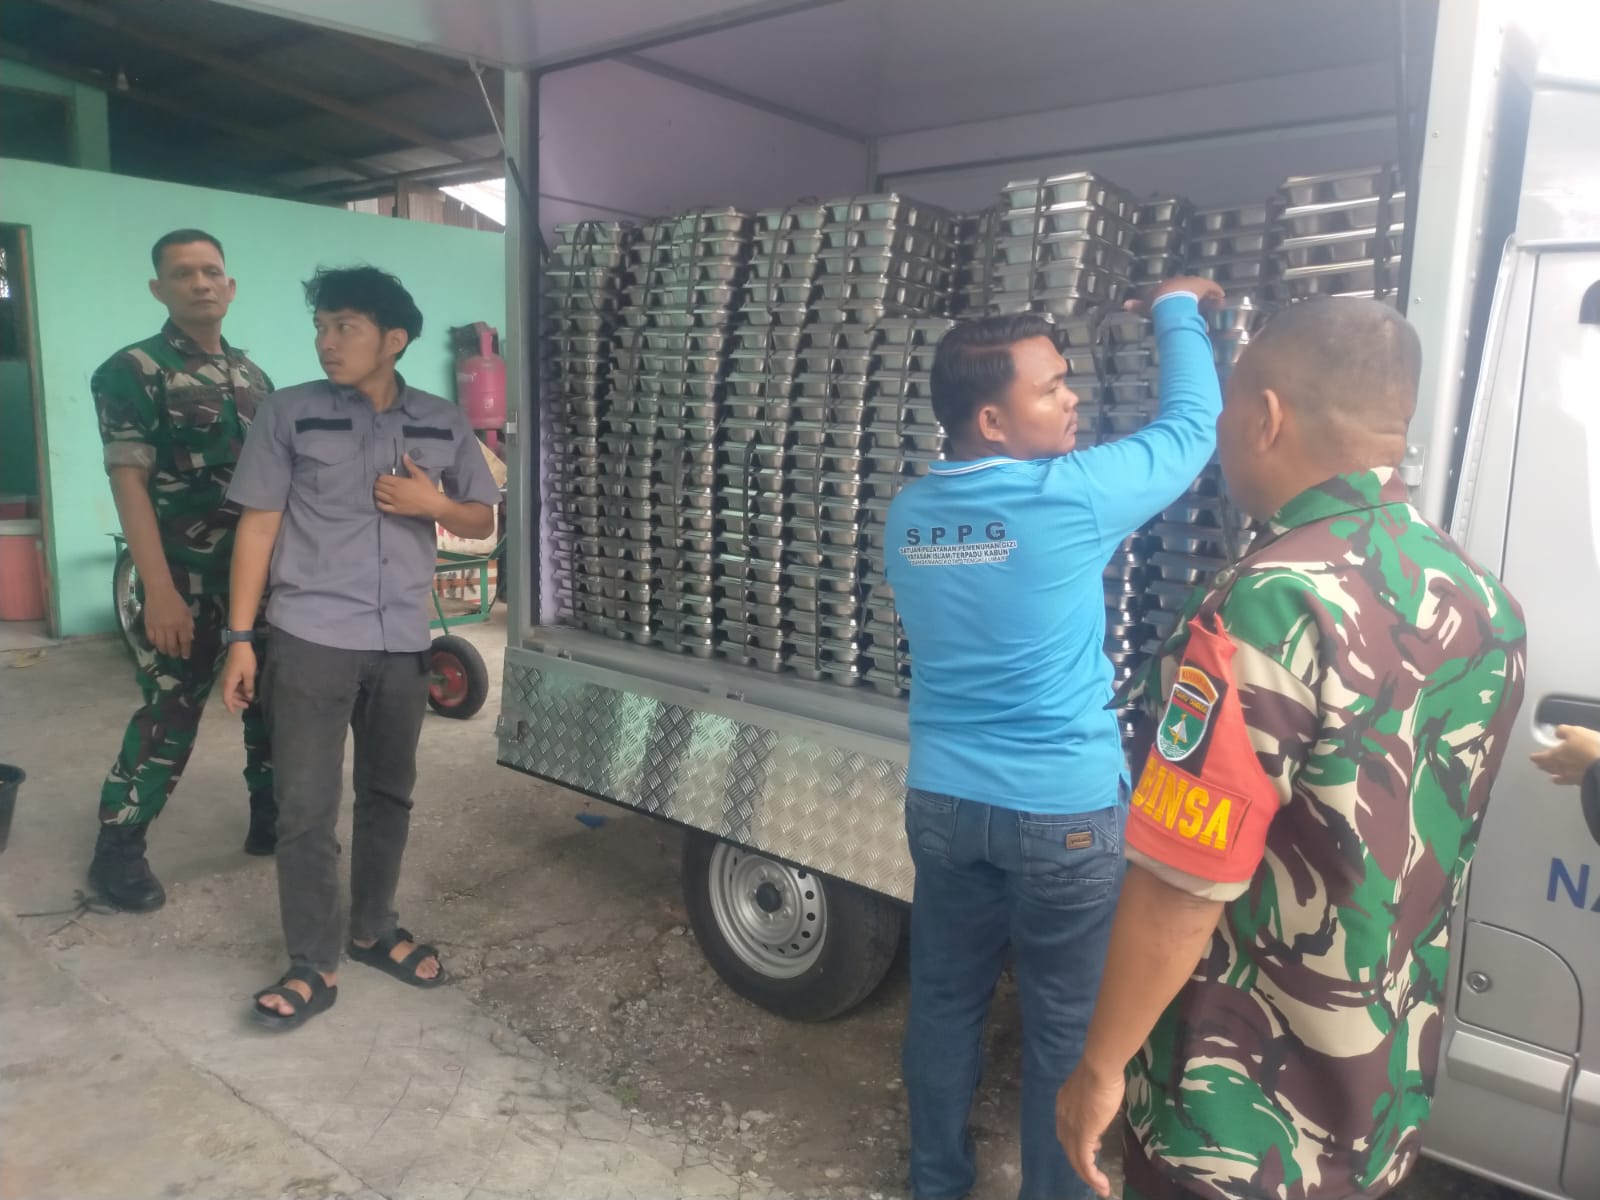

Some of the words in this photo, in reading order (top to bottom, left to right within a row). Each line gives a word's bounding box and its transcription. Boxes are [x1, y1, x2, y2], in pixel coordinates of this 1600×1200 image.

[1001, 540, 1017, 548] GIZI
[952, 550, 982, 559] TERPADU
[1547, 857, 1600, 913] N
